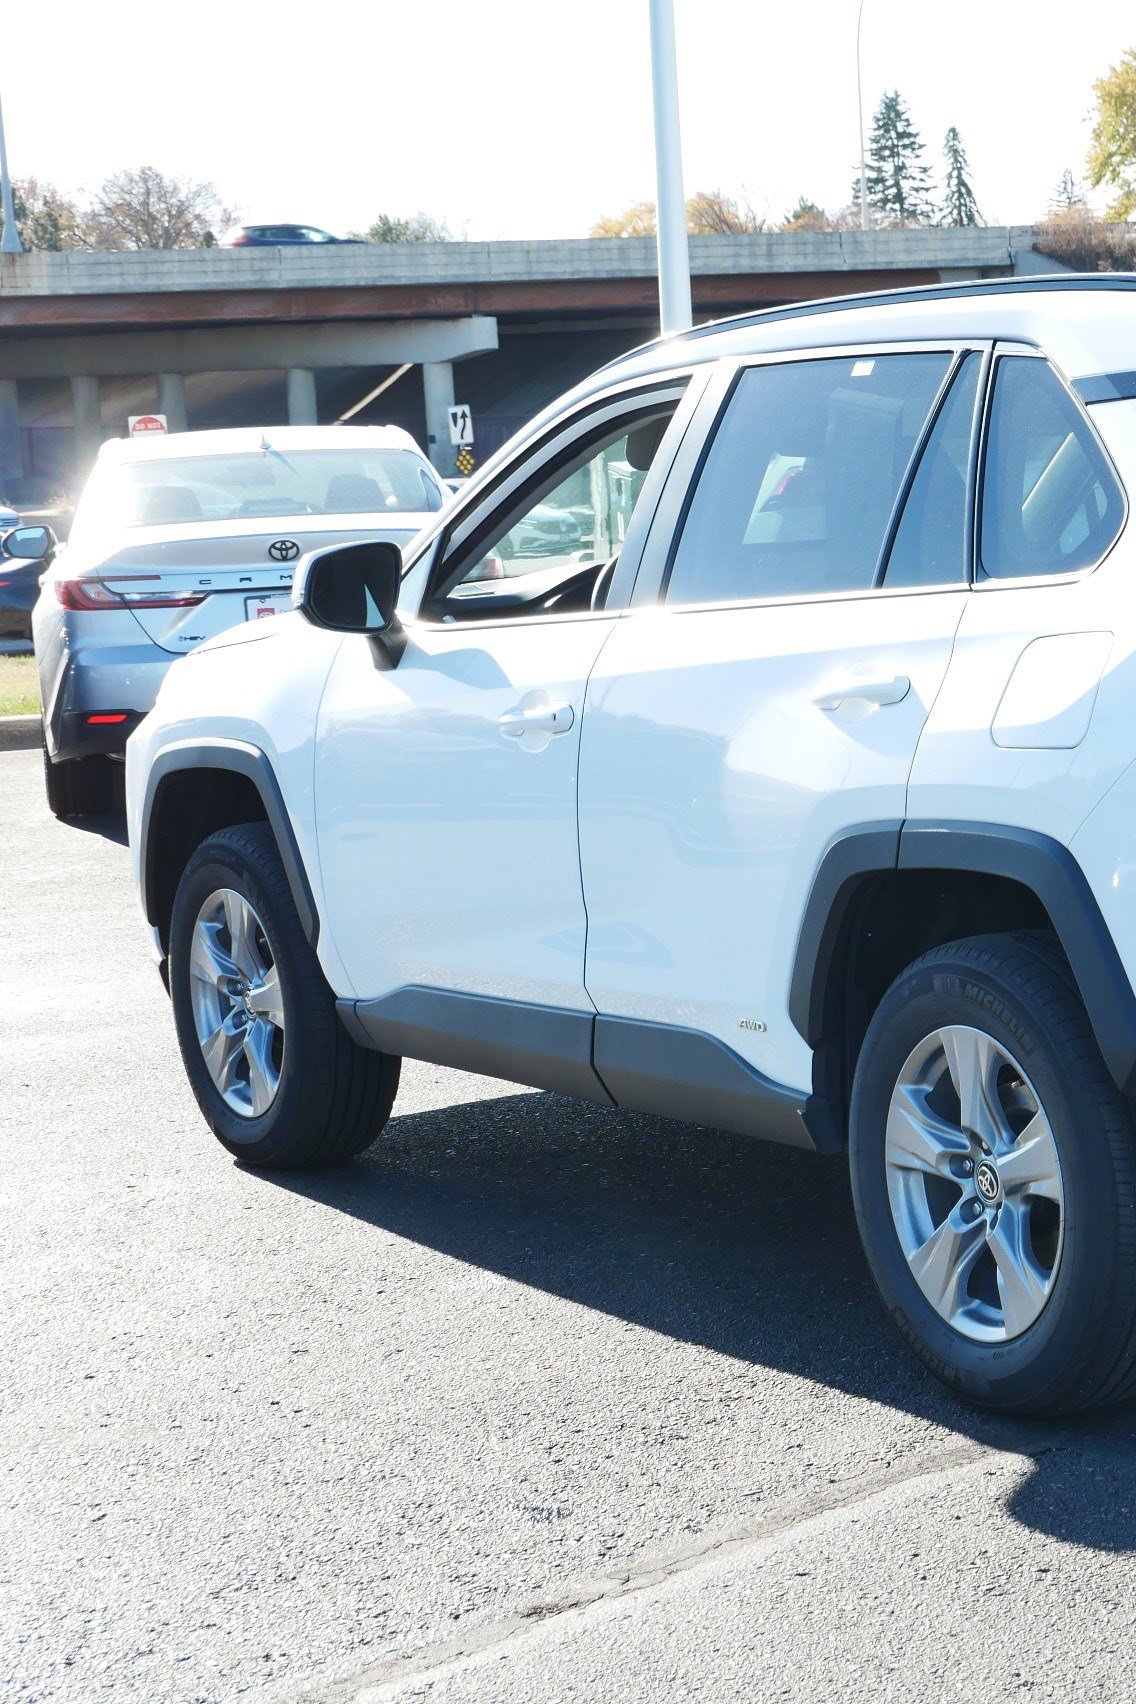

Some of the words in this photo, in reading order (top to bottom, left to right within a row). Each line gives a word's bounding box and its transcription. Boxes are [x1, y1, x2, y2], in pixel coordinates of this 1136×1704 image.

[135, 423, 146, 431] DO
[147, 422, 162, 430] NOT
[198, 574, 293, 585] CAM
[964, 982, 1034, 1054] MICHELIN
